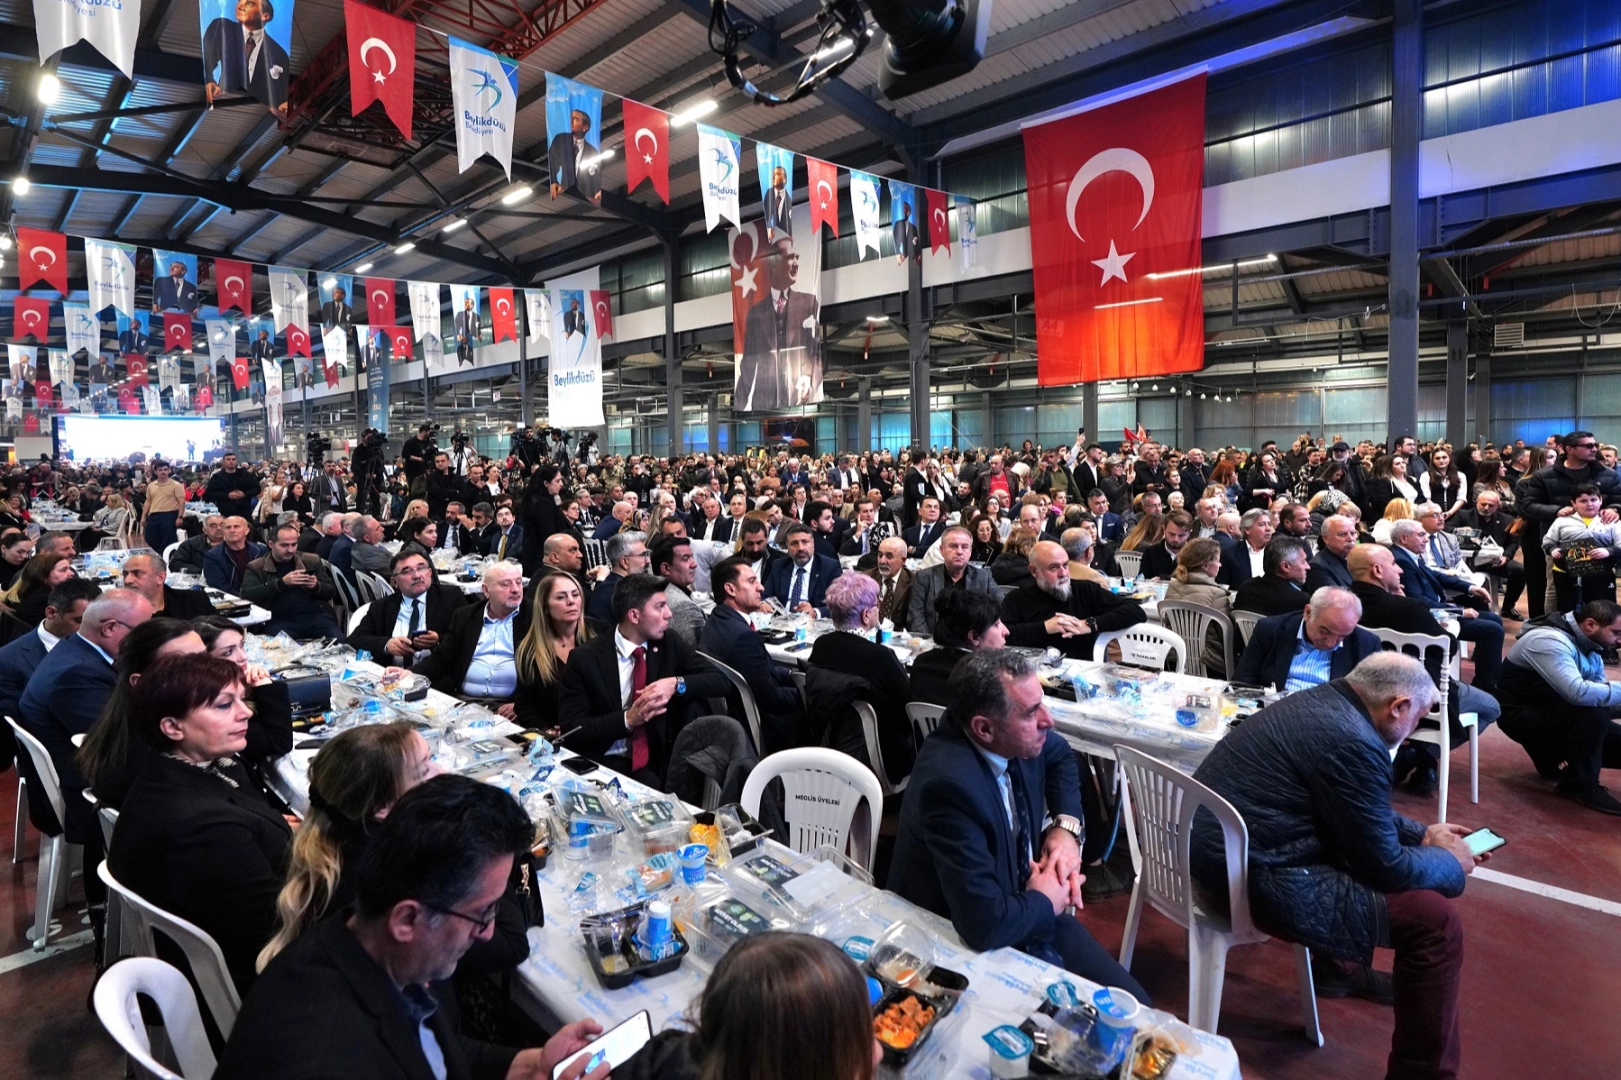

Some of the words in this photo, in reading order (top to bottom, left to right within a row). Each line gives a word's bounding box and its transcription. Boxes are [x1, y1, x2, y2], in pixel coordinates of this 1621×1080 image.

[554, 369, 596, 388] Beylikdüzü
[795, 794, 817, 803] MECLİS
[817, 795, 840, 806] ÜYELERİ
